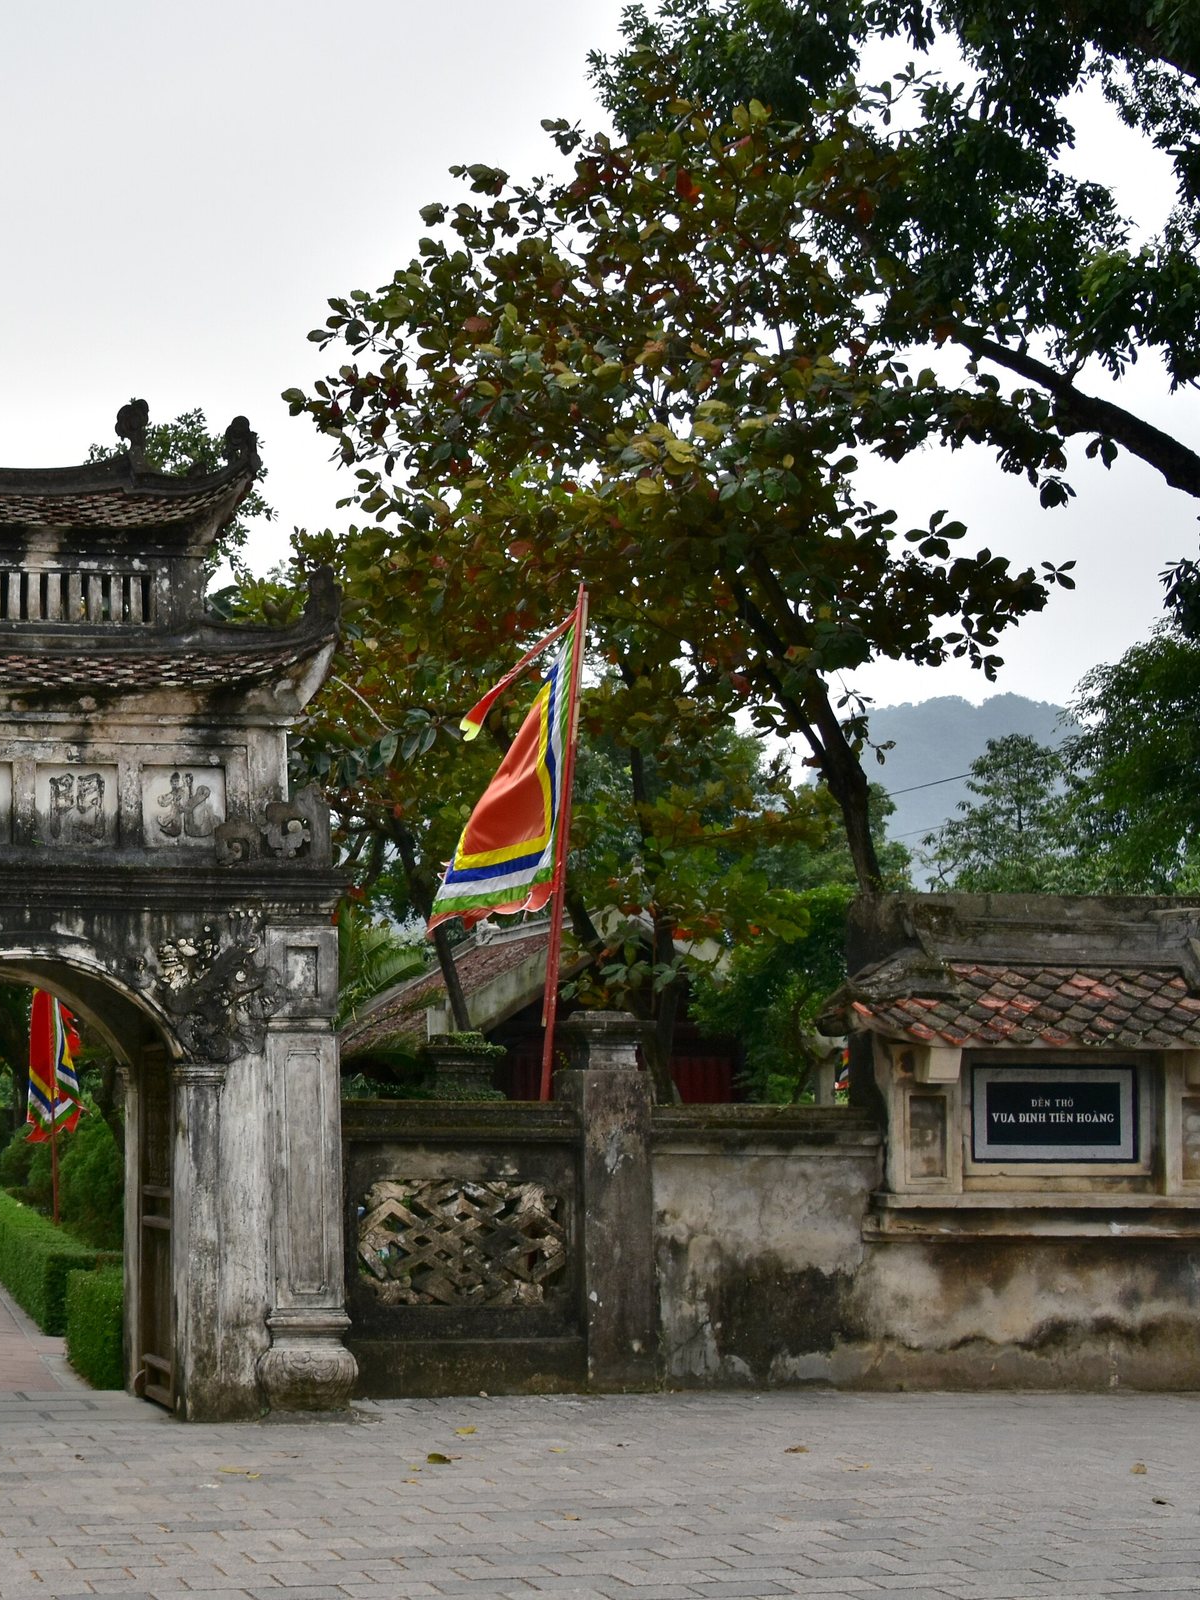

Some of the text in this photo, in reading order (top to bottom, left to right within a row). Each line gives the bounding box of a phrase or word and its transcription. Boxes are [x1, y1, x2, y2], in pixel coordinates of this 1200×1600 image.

[991, 1110, 1115, 1123] VUA ĐINH TIÊN HOÀNG
